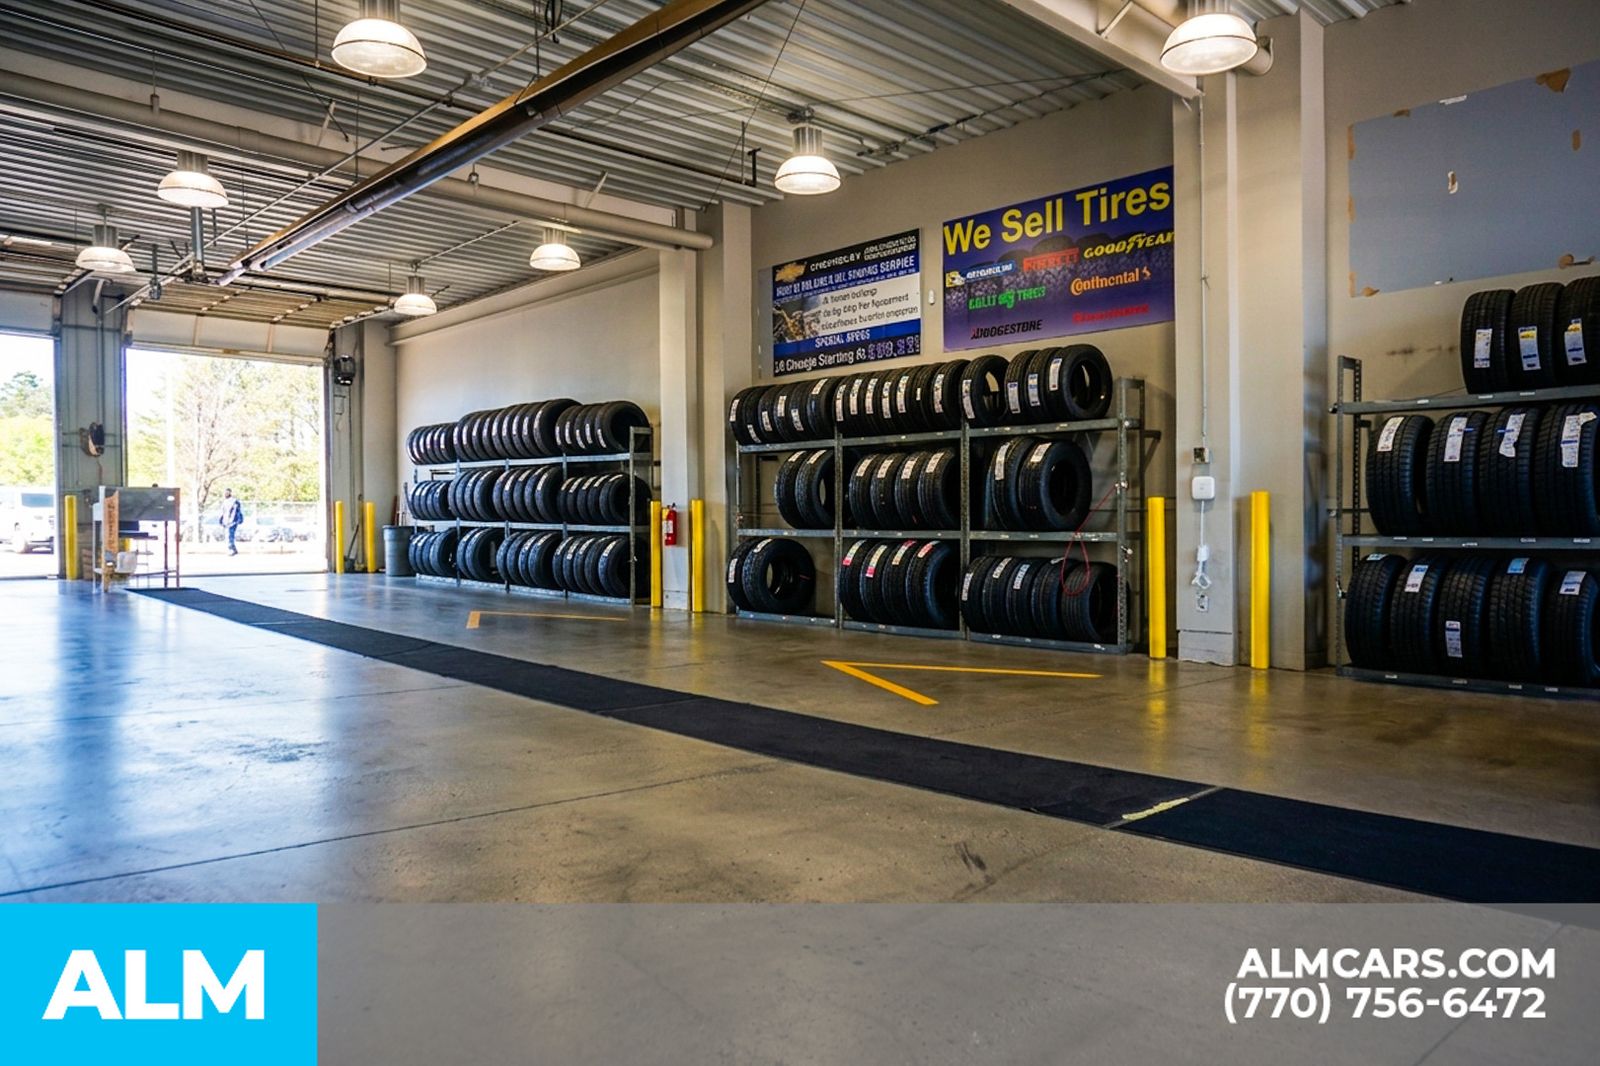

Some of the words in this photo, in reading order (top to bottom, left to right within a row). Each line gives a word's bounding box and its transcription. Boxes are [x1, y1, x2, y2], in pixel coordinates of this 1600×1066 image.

[943, 219, 991, 255] We
[1001, 198, 1063, 243] Sell
[1076, 182, 1171, 226] Tires
